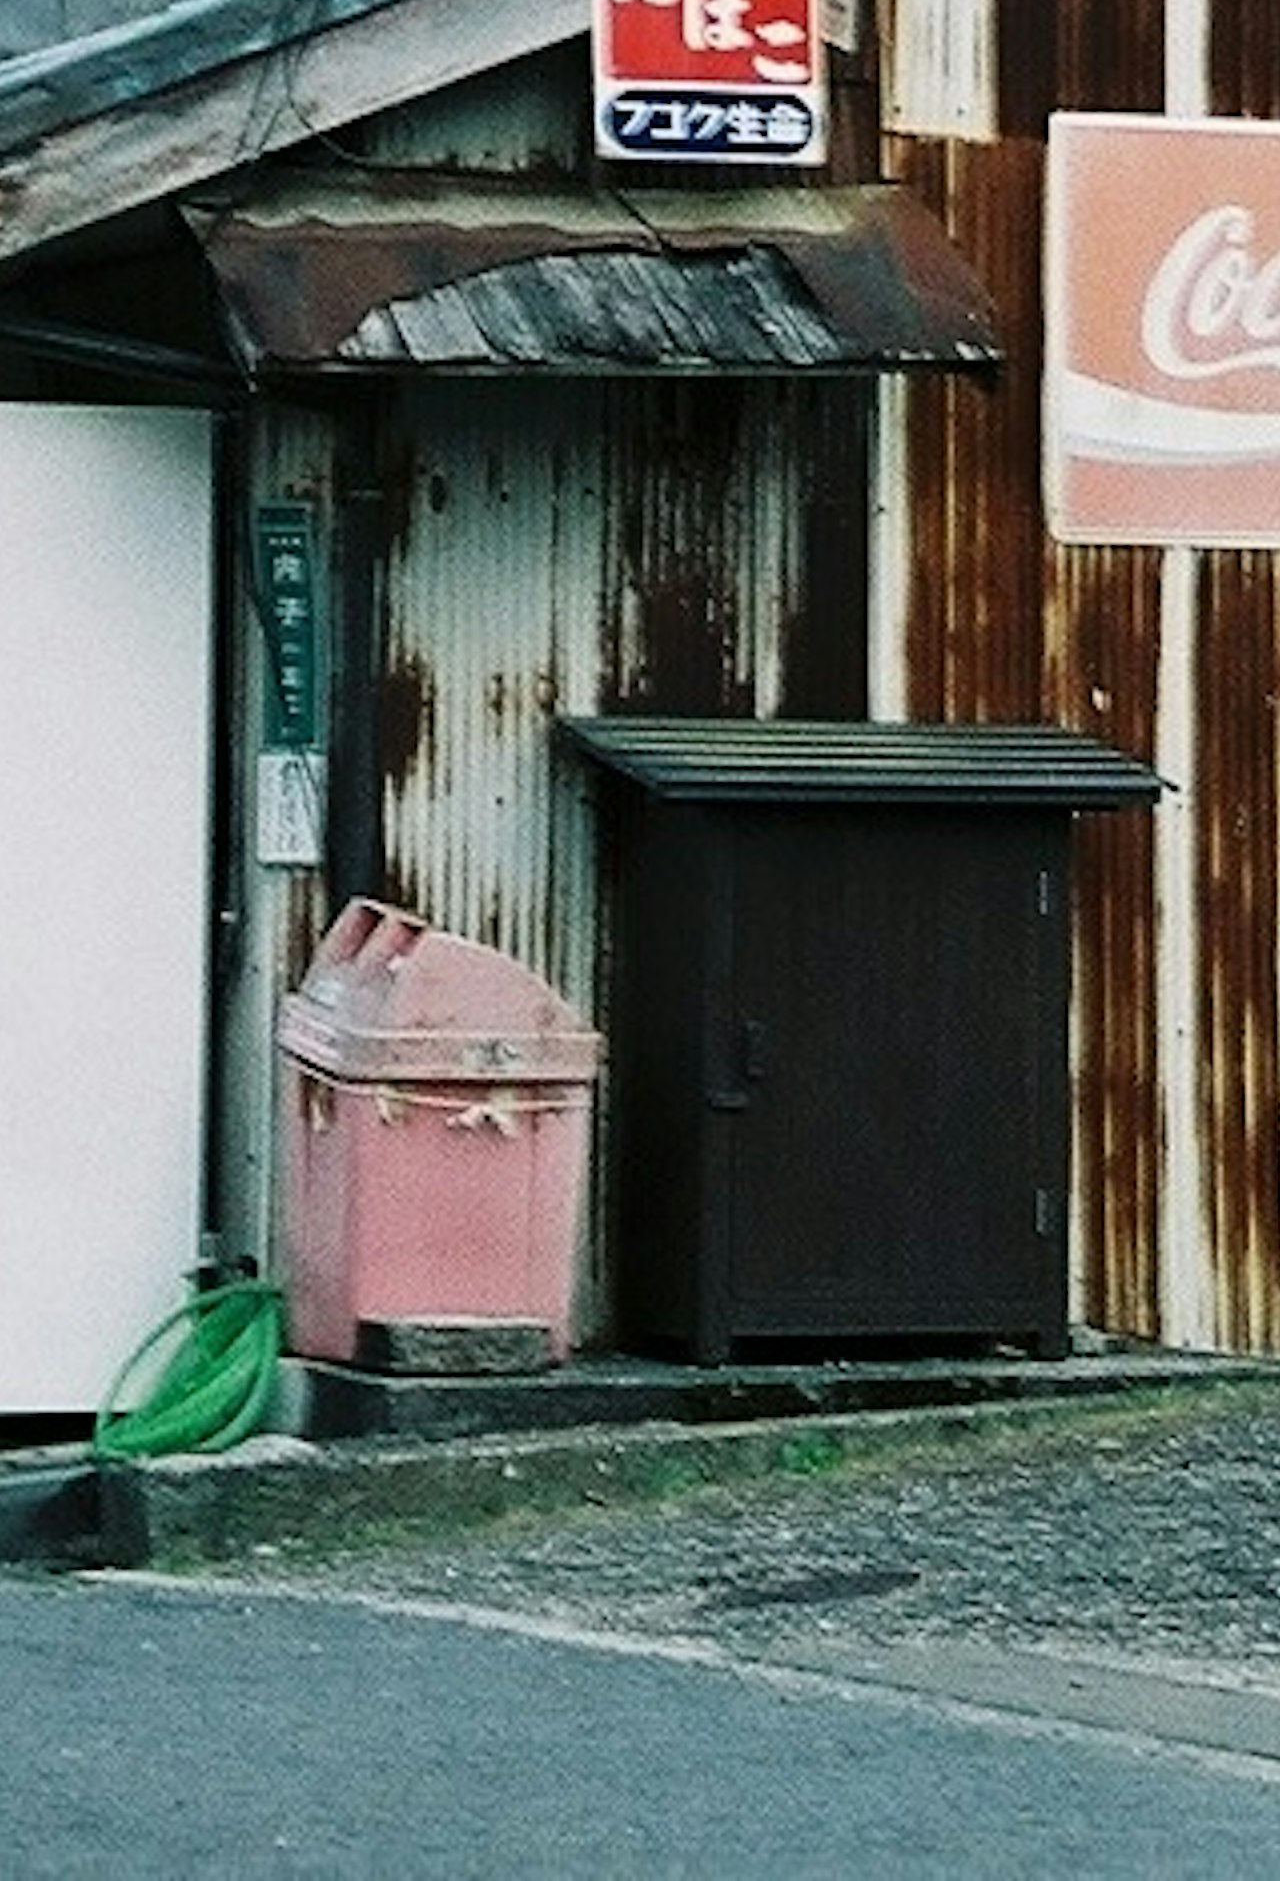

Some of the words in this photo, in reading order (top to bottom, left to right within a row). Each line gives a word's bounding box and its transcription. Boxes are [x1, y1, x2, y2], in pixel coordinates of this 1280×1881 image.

[614, 98, 810, 145] フコク生命
